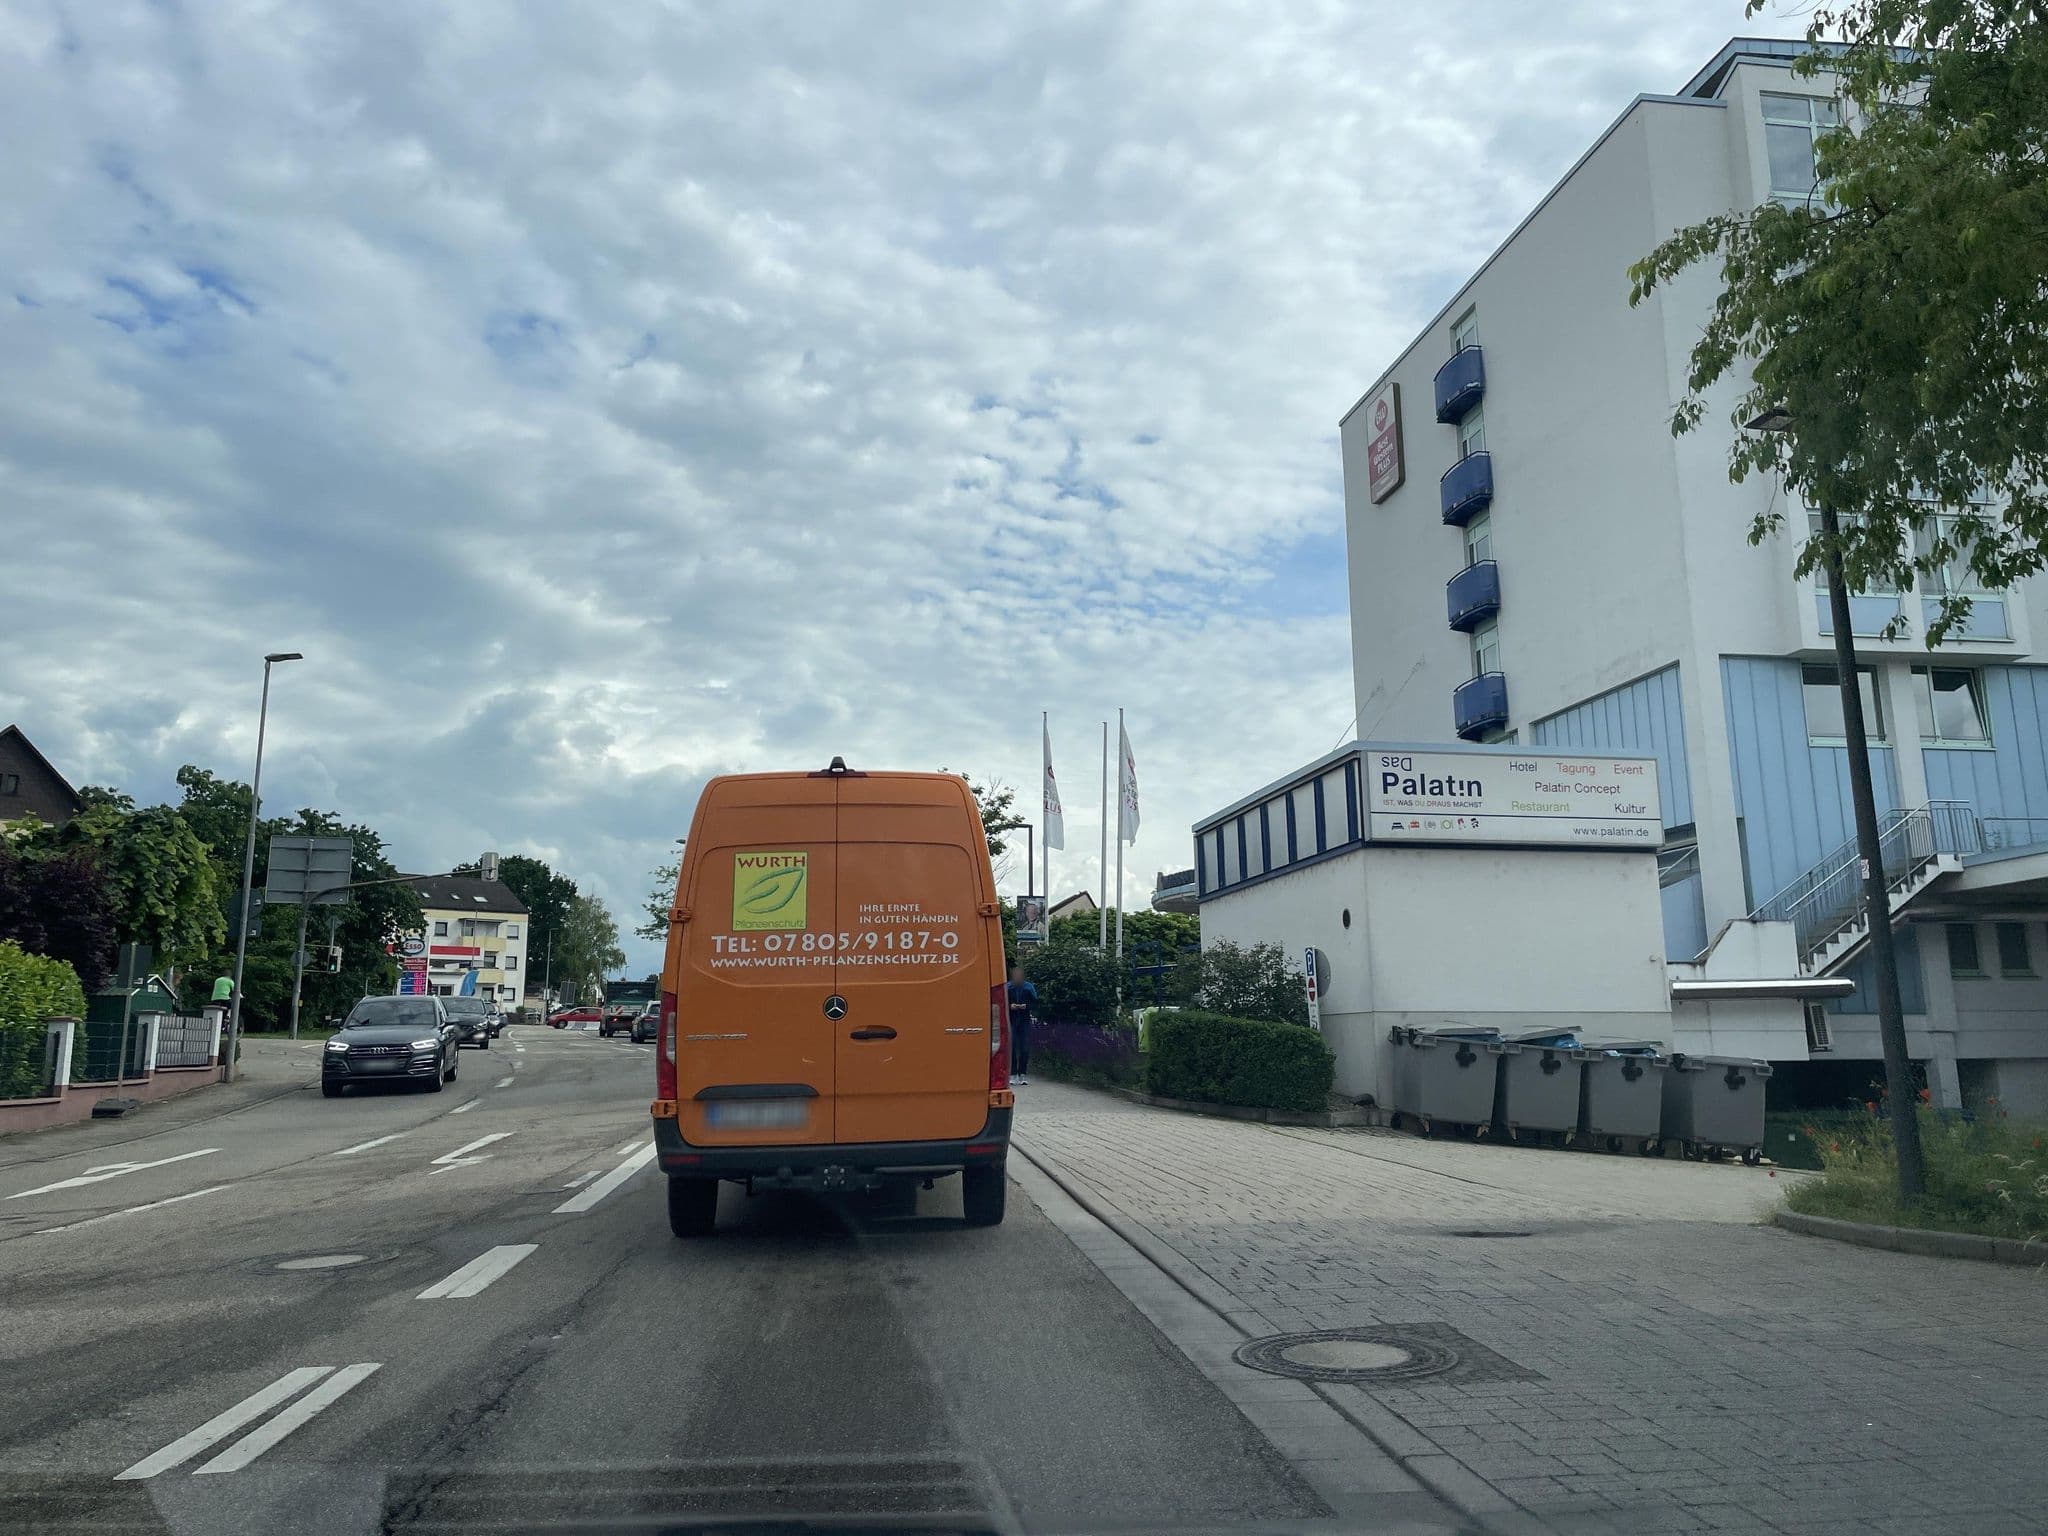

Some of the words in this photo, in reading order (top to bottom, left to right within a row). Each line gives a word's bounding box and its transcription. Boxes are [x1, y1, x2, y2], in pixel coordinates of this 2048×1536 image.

[1381, 756, 1412, 772] Das
[1509, 761, 1538, 773] Hotel
[1556, 762, 1596, 776] Tagung
[1613, 763, 1644, 775] Event
[1534, 781, 1571, 793] Palatin
[1574, 782, 1621, 796] Concept
[1397, 799, 1414, 807] WAS
[1426, 800, 1452, 808] DRAUS
[1511, 800, 1570, 812] Restaurant
[1614, 803, 1646, 814] Kultur
[1573, 826, 1649, 838] www.palatin.de
[738, 856, 806, 868] WURTH
[859, 904, 885, 913] IHRE
[887, 903, 921, 912] ERNTE
[735, 919, 805, 929] Pflanzenschutz
[859, 915, 871, 924] IN
[874, 915, 909, 924] GUTEN
[764, 931, 959, 952] 07805/9187-0
